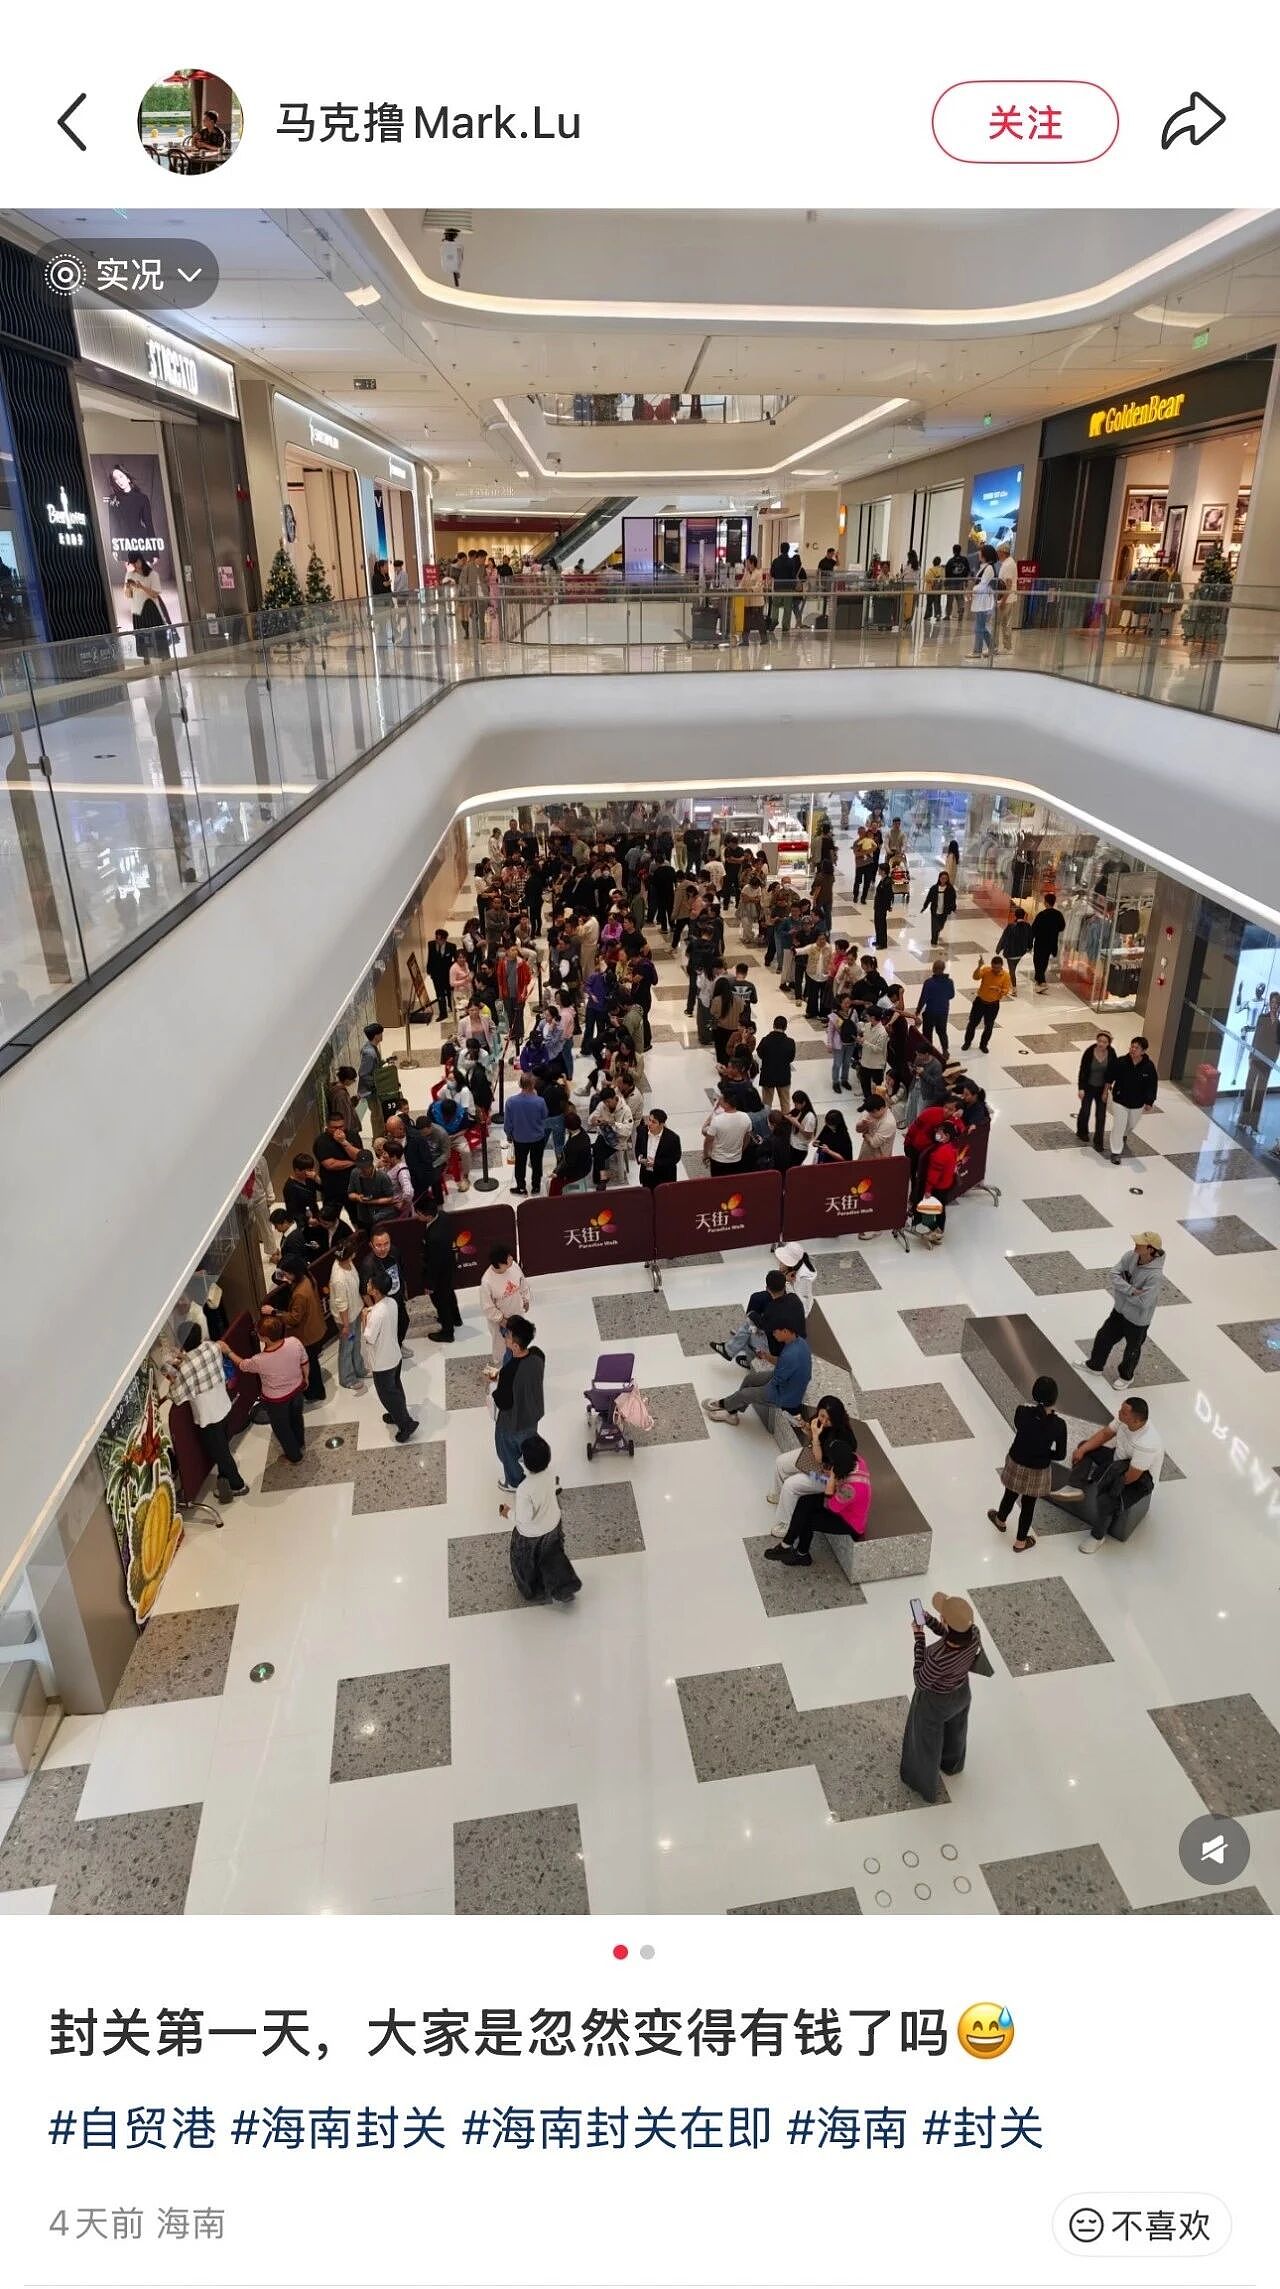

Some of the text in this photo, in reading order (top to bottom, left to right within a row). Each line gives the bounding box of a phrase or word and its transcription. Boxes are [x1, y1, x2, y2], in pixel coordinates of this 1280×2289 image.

[1105, 393, 1185, 434] GoldenBear
[111, 537, 164, 551] STACCATO
[1021, 565, 1036, 574] SALE
[825, 1195, 858, 1212] 天街
[696, 1211, 728, 1230] 天街
[564, 1227, 600, 1246] 天街
